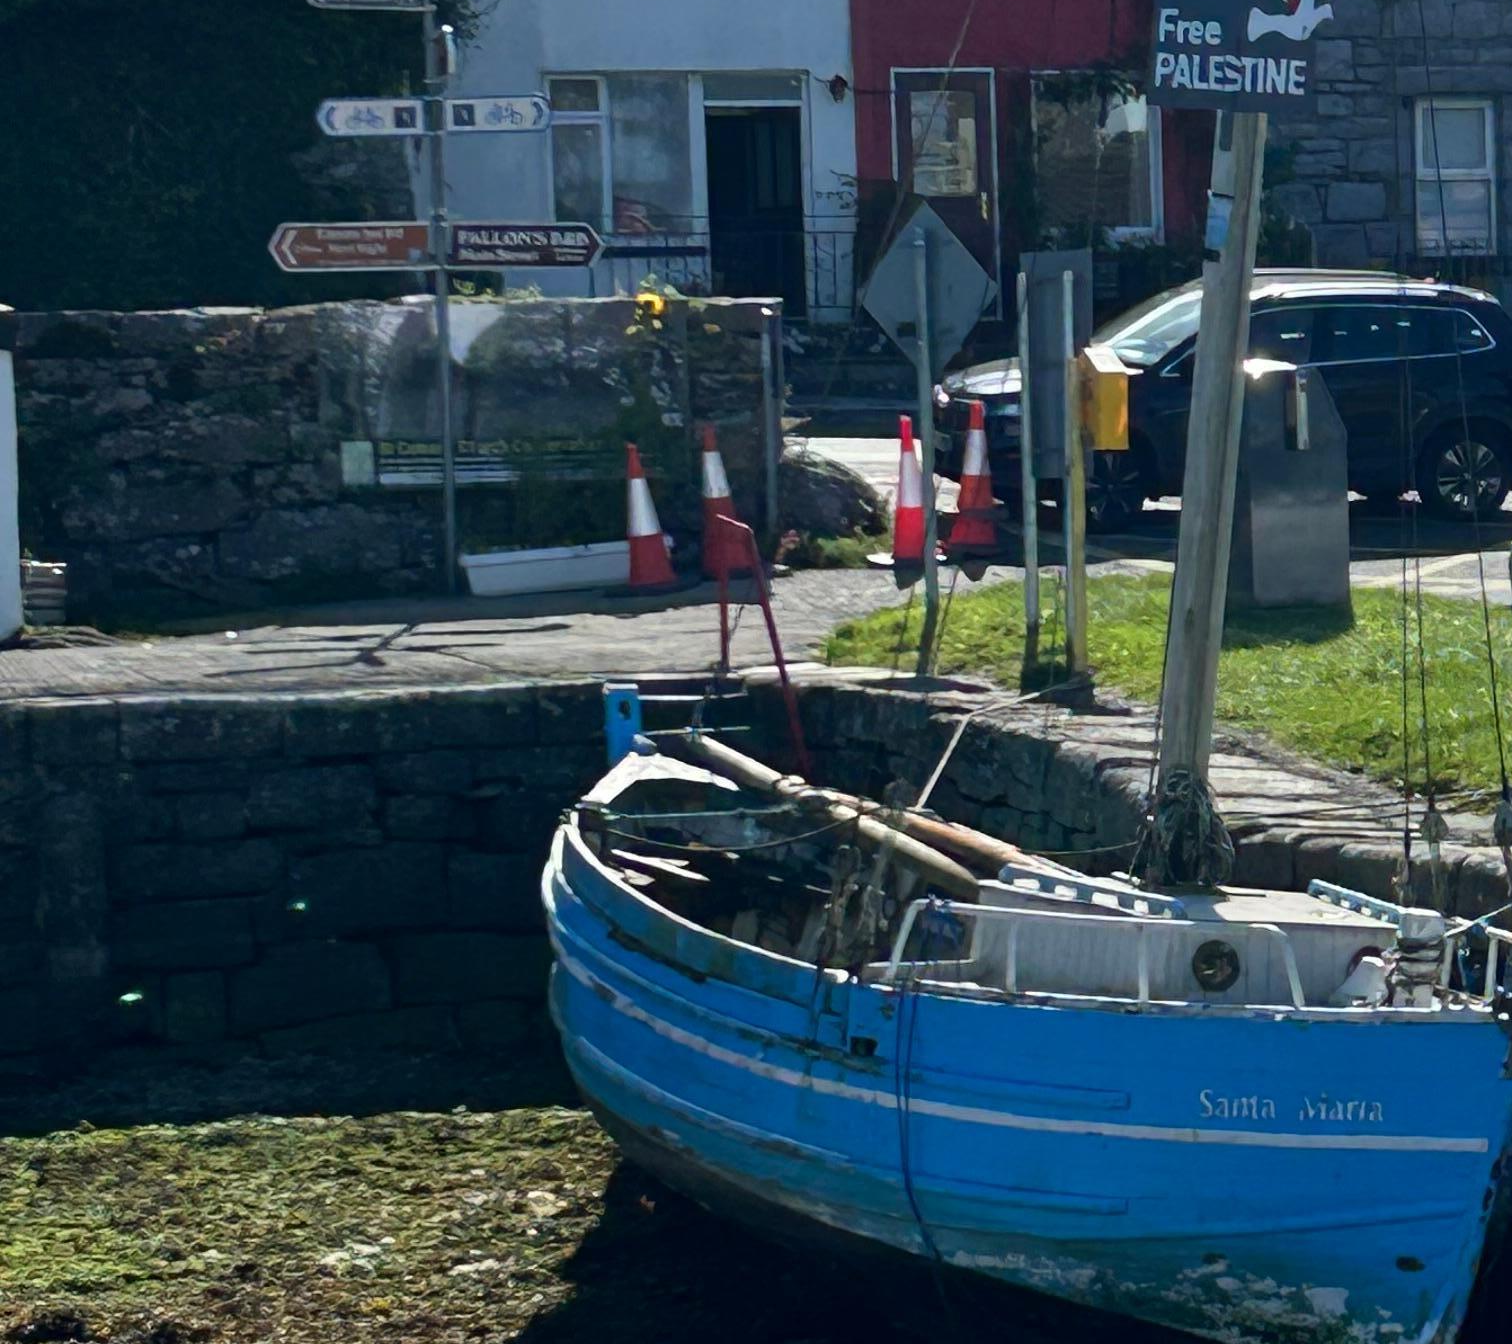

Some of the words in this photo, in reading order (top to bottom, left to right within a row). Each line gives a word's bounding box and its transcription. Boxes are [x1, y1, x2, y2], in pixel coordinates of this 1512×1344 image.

[1159, 8, 1222, 45] Free
[1155, 52, 1307, 95] PALESTINE
[1200, 1089, 1276, 1120] Santa
